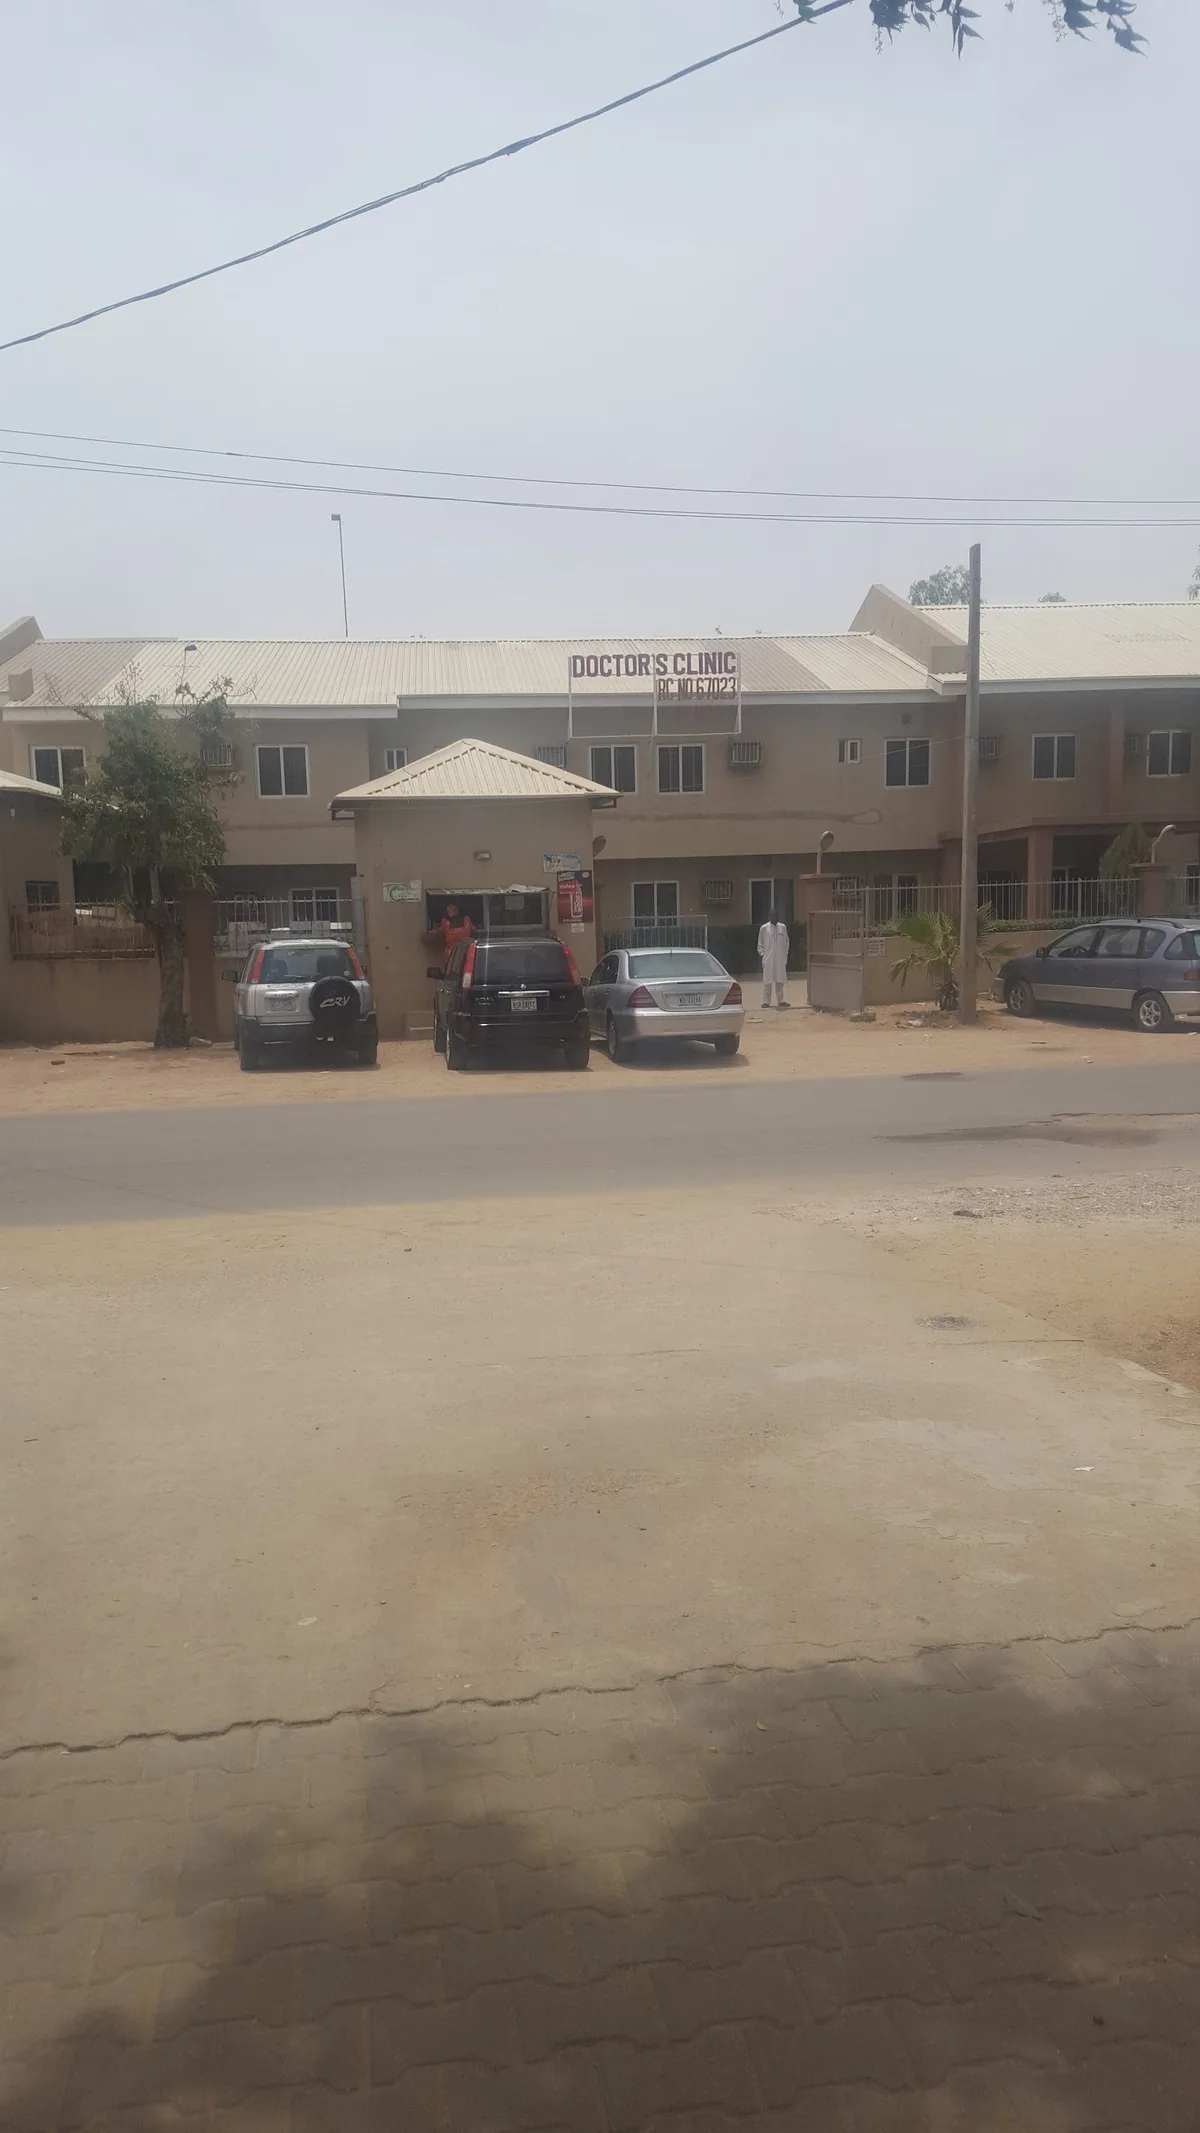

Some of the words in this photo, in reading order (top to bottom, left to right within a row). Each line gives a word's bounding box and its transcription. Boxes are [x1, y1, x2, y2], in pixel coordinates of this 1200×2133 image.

[572, 653, 668, 677] DOCTOR'S
[673, 652, 737, 676] CLINIC
[658, 677, 675, 700] RC
[678, 678, 693, 700] NO
[696, 677, 737, 700] 67023
